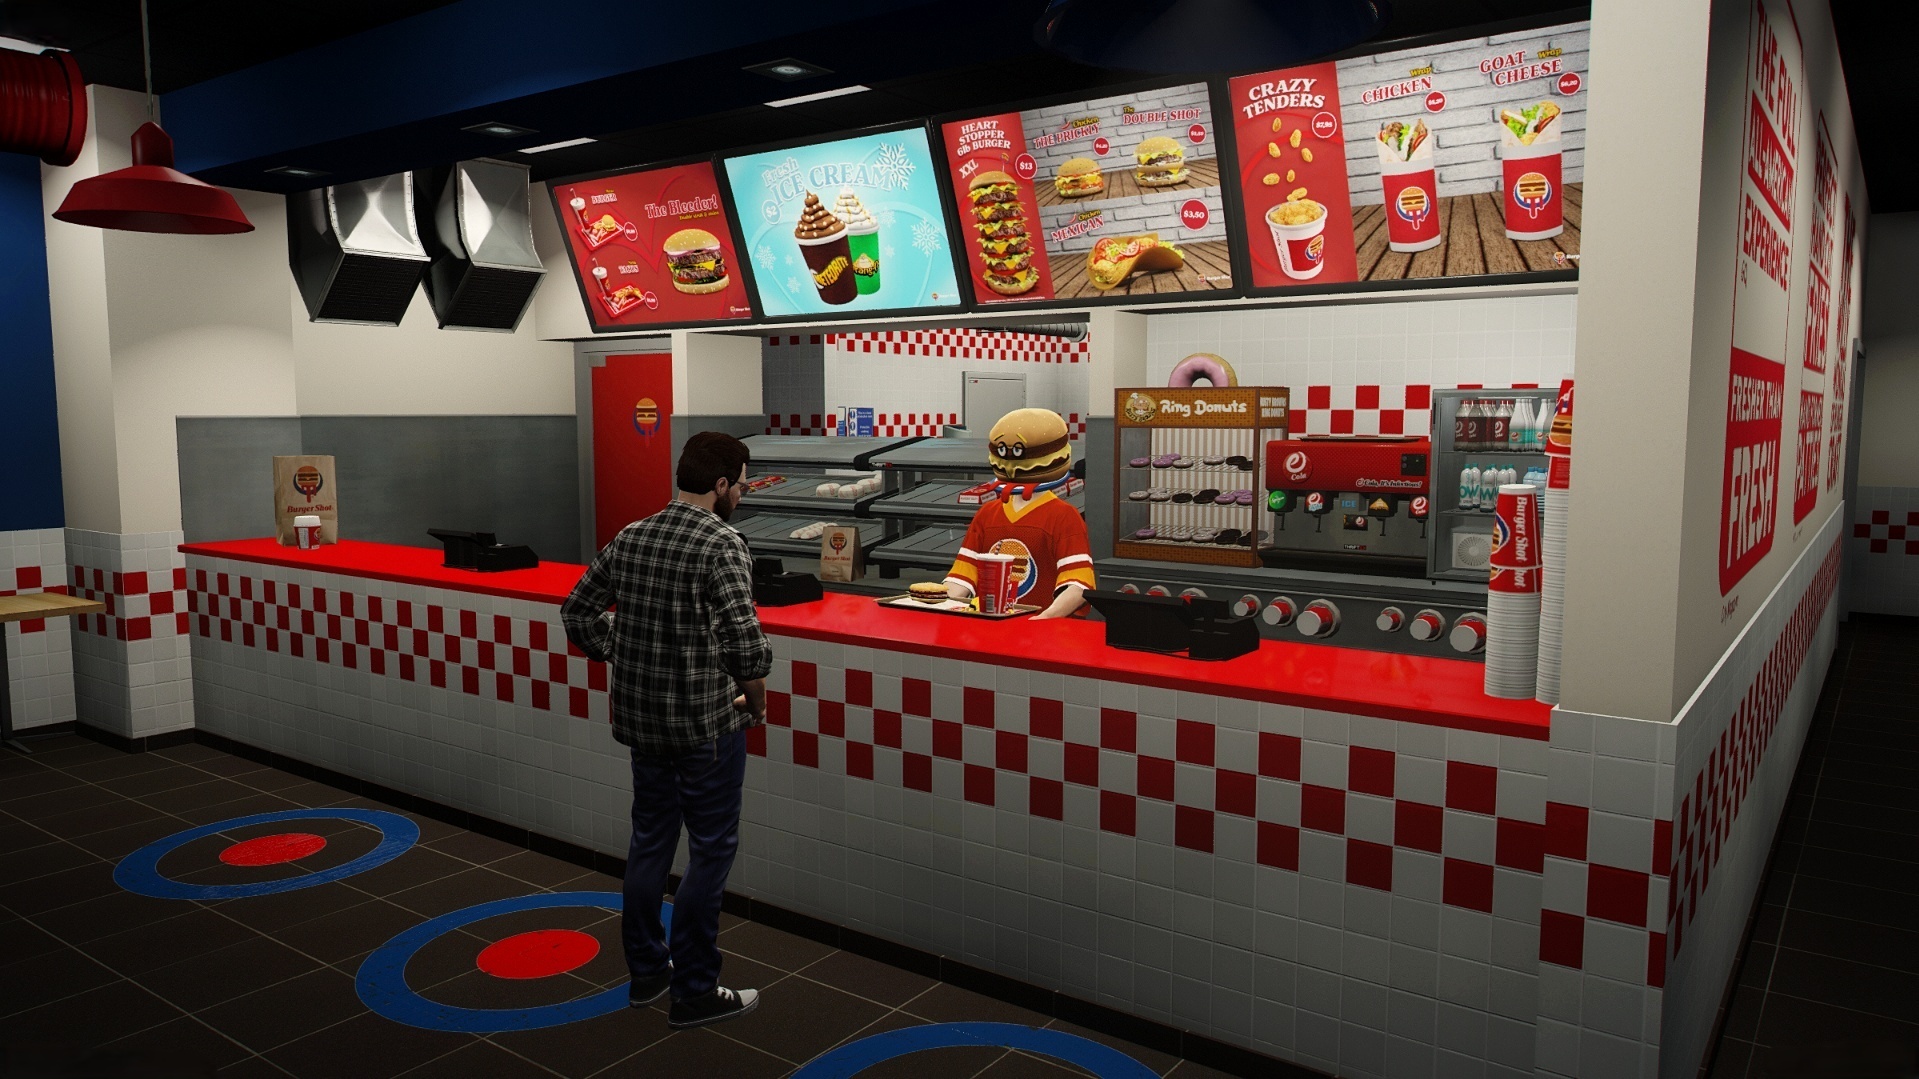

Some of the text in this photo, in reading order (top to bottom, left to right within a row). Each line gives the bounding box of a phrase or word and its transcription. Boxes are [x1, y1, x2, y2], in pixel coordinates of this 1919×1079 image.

[1479, 50, 1526, 74] GOAT
[1537, 48, 1562, 59] Wrap
[1410, 66, 1432, 77] Wrap
[1494, 58, 1562, 87] CHEESE
[1755, 0, 1797, 160] THE FULL
[1249, 78, 1317, 101] CRAZY
[1361, 77, 1433, 105] CHICKEN
[1123, 105, 1135, 114] The
[1243, 94, 1325, 119] TENDERS
[1072, 116, 1099, 128] Chicken
[1122, 108, 1201, 125] DOUBLE SHOT
[961, 121, 999, 134] HEART
[1033, 122, 1101, 149] THE PRICKLY
[958, 130, 1005, 145] STOPPER
[957, 139, 1011, 157] 6lb BURGER
[762, 156, 799, 186] Fresh
[959, 159, 979, 179] XXL
[1019, 161, 1033, 171] $13
[768, 162, 893, 206] ICE CREAM
[645, 195, 719, 219] The Bleeder!
[766, 205, 777, 216] $2
[1078, 209, 1101, 222] Chicken
[1183, 210, 1205, 219] $3,50
[1051, 215, 1105, 243] MEXICAN
[1743, 193, 1790, 292] EXPERIENCE
[1730, 374, 1764, 423] FRESHER
[1765, 379, 1782, 420] THAN
[1160, 400, 1191, 417] Ring
[1194, 400, 1247, 415] Donuts
[1291, 472, 1307, 480] Cola
[287, 504, 331, 513] Burger Shot
[1342, 500, 1356, 508] ICE
[1726, 439, 1777, 570] FRESH
[1514, 497, 1528, 561] Burger Shot
[1514, 569, 1528, 588] hot
